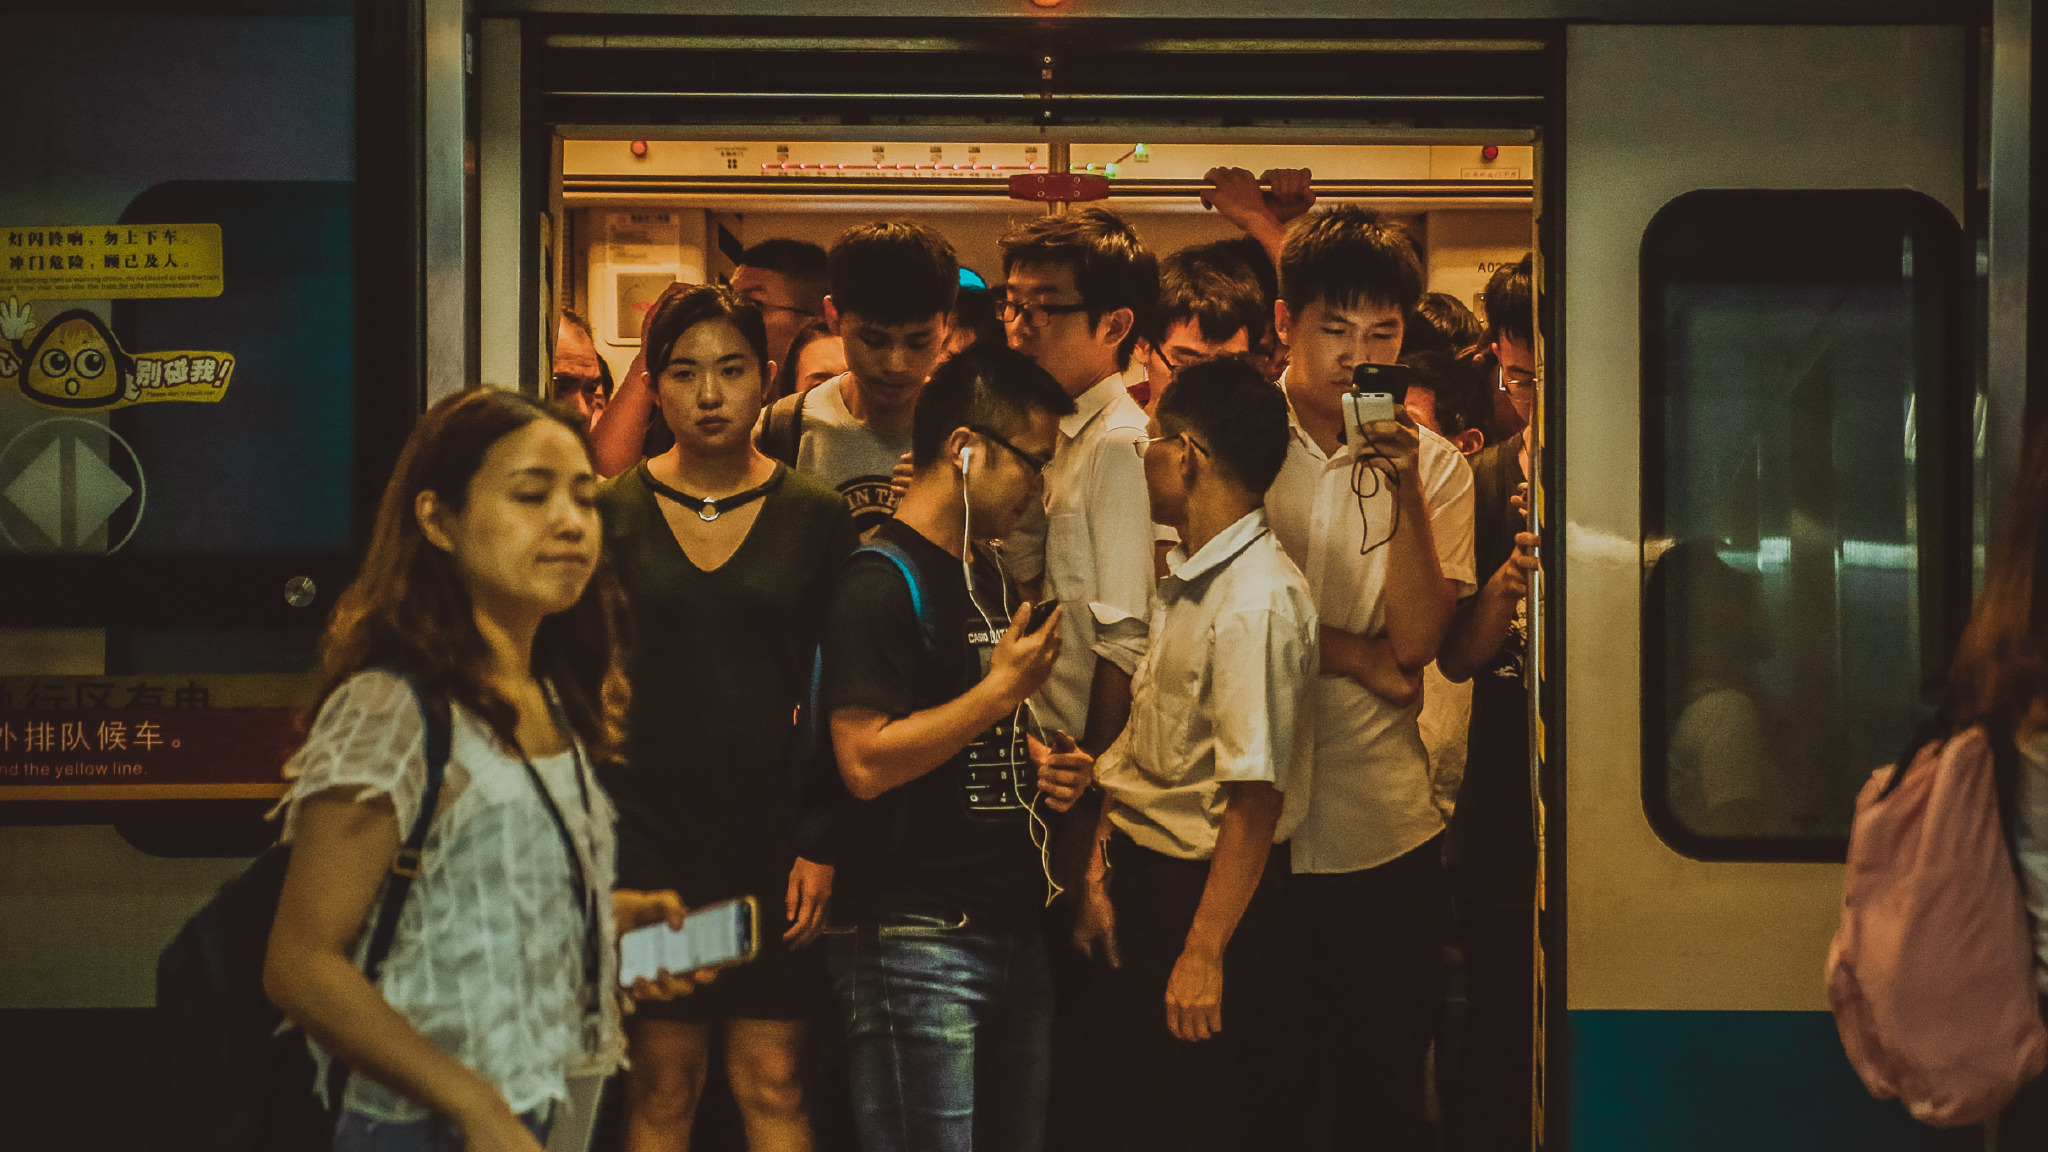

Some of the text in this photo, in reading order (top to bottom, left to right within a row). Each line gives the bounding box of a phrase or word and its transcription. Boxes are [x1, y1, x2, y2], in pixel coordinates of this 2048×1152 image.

[843, 488, 870, 511] IN
[989, 628, 1009, 644] DAT
[969, 751, 978, 760] 4
[24, 762, 49, 776] the
[55, 761, 108, 779] yellow
[113, 760, 149, 775] line.
